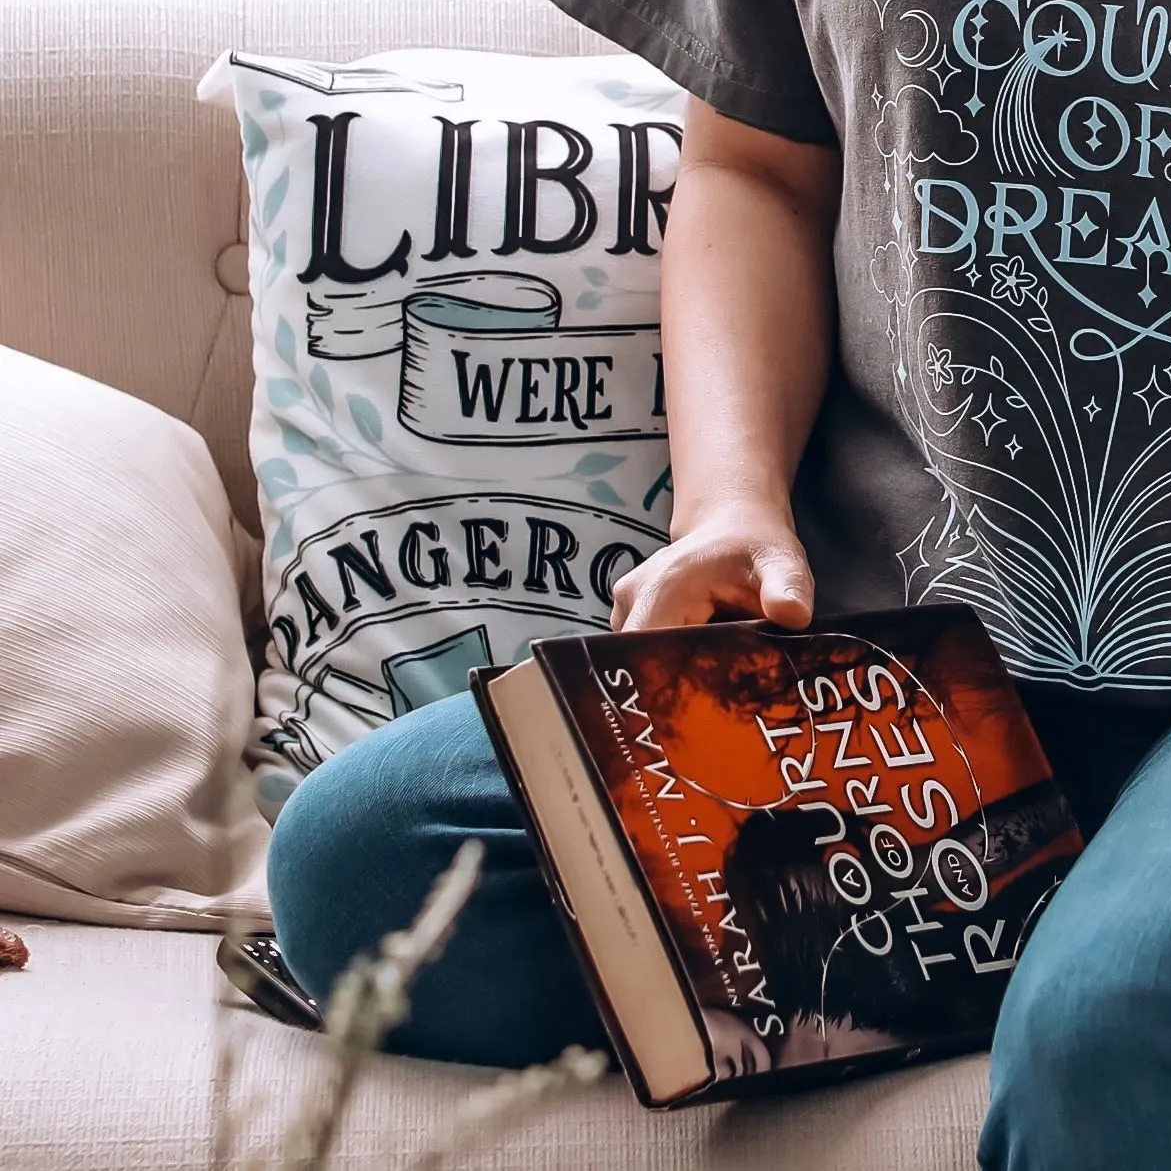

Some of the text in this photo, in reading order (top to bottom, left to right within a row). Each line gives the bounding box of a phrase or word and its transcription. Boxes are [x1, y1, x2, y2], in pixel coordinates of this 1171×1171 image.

[297, 111, 684, 284] LIBR
[450, 350, 613, 429] WERE
[600, 700, 742, 1007] NEW YORK TIMES BESTSELLING AUTHOR
[604, 667, 785, 1038] SARAH J. MAAS
[755, 713, 894, 956] A COURT
[797, 676, 957, 981] OF THORNS
[846, 664, 1018, 975] AND ROSES
